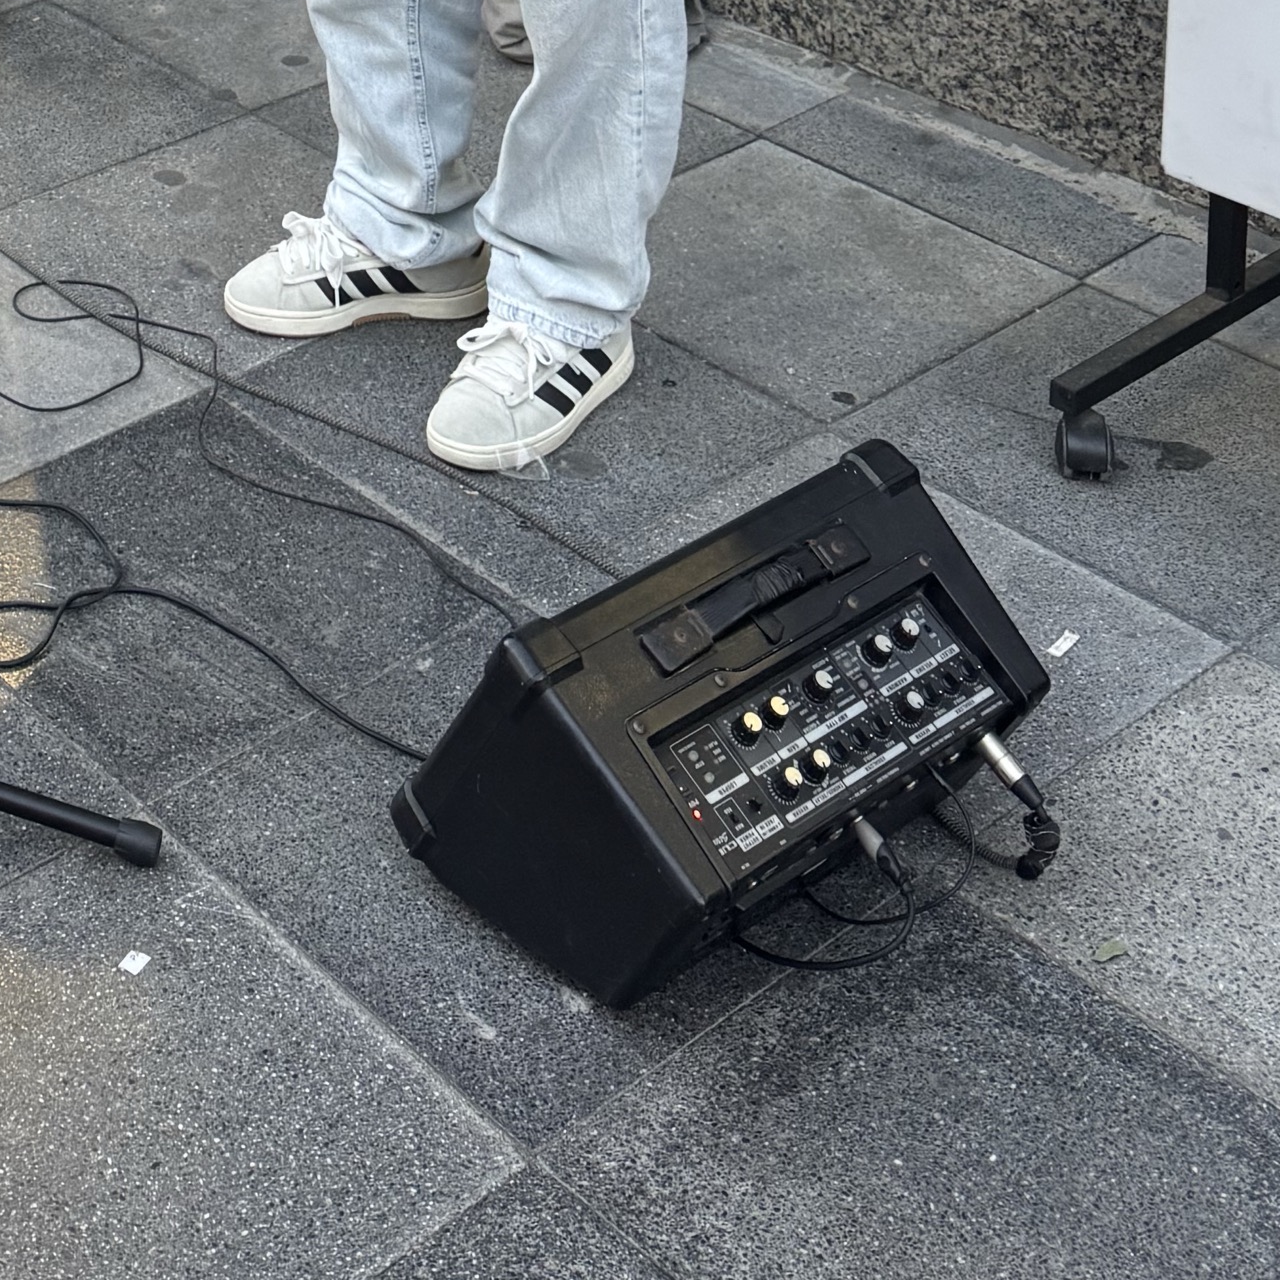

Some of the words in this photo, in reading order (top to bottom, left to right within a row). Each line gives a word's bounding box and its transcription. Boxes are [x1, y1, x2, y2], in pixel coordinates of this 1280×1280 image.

[938, 646, 955, 660] SELECT
[914, 659, 933, 675] VOLUME
[884, 675, 908, 693] HARMONY
[824, 718, 838, 730] TYPE
[836, 712, 848, 722] AMP
[785, 742, 799, 754] GAIN
[755, 756, 776, 773] VOLUME
[717, 780, 737, 796] LOOPER
[791, 804, 809, 818] REVERB
[738, 830, 755, 844] POWER
[741, 835, 760, 850] OUTPUT
